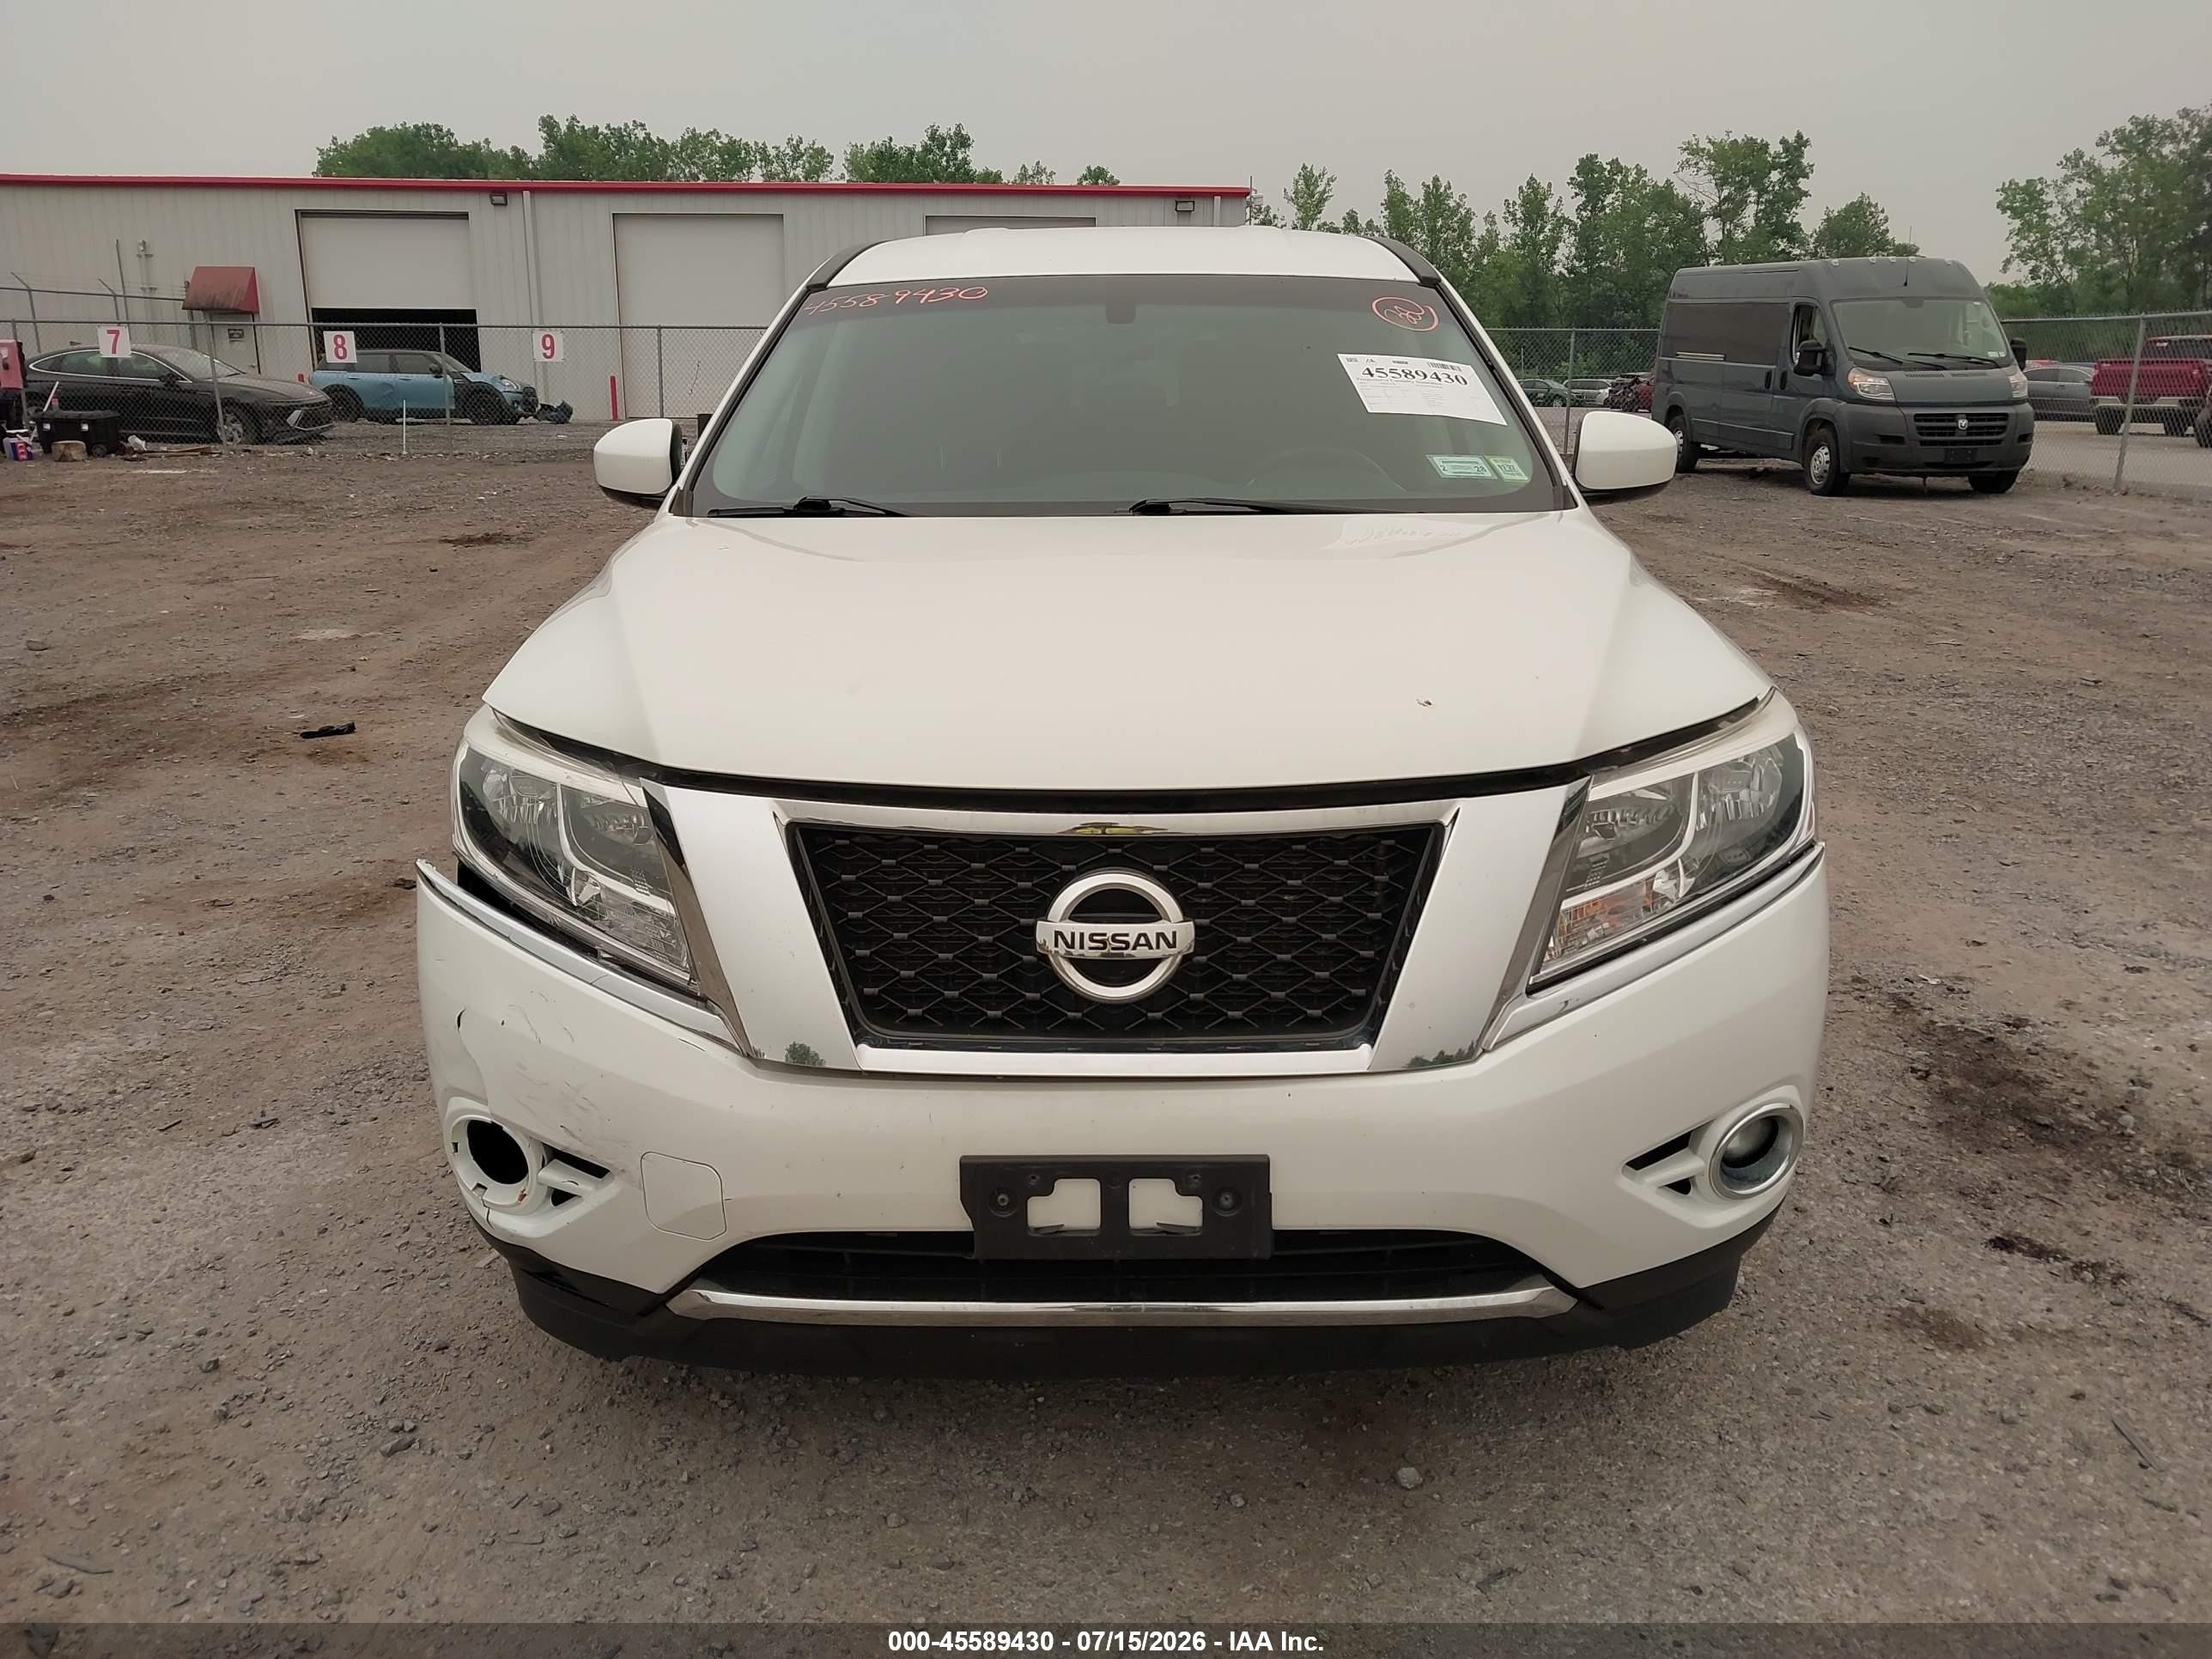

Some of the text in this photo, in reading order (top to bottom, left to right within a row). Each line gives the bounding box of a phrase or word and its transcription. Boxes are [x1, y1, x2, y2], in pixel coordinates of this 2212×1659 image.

[106, 330, 119, 354] 7
[334, 335, 347, 360] 8
[542, 334, 555, 359] 9
[1362, 367, 1468, 386] 45589430
[1054, 930, 1177, 951] NISSAN
